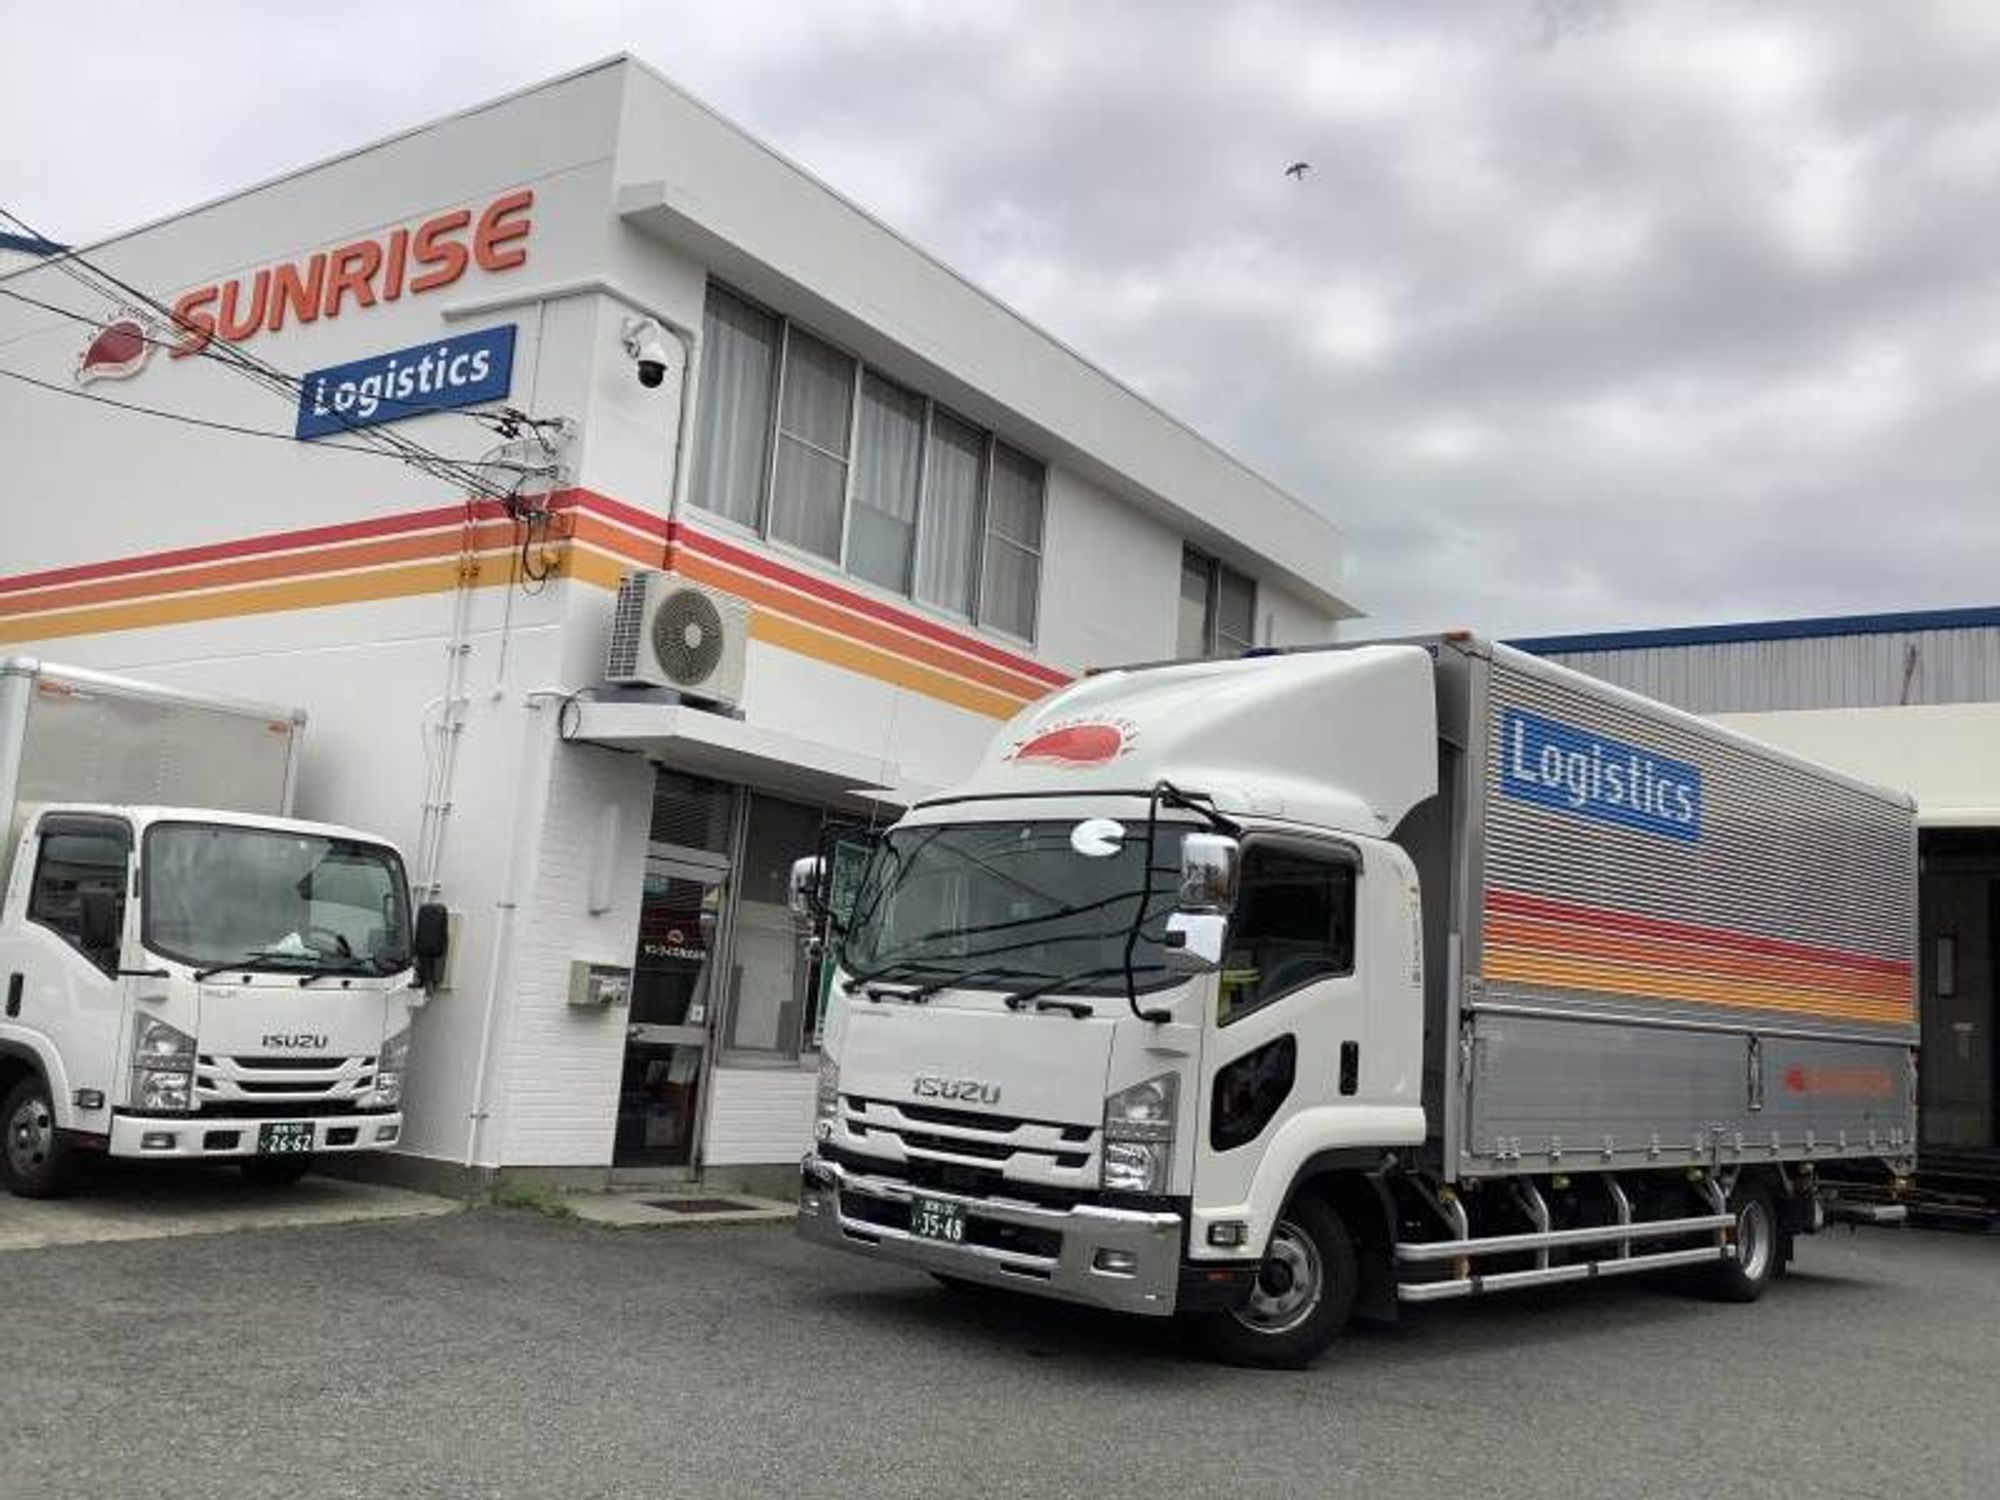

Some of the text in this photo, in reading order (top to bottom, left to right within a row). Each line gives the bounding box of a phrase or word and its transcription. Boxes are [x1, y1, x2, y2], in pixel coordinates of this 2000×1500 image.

[169, 188, 533, 359] SUNRISE
[313, 347, 490, 417] Logistics
[1513, 720, 1692, 822] Logistics
[262, 1034, 328, 1049] ISUZU
[913, 1078, 1001, 1104] ISUZU
